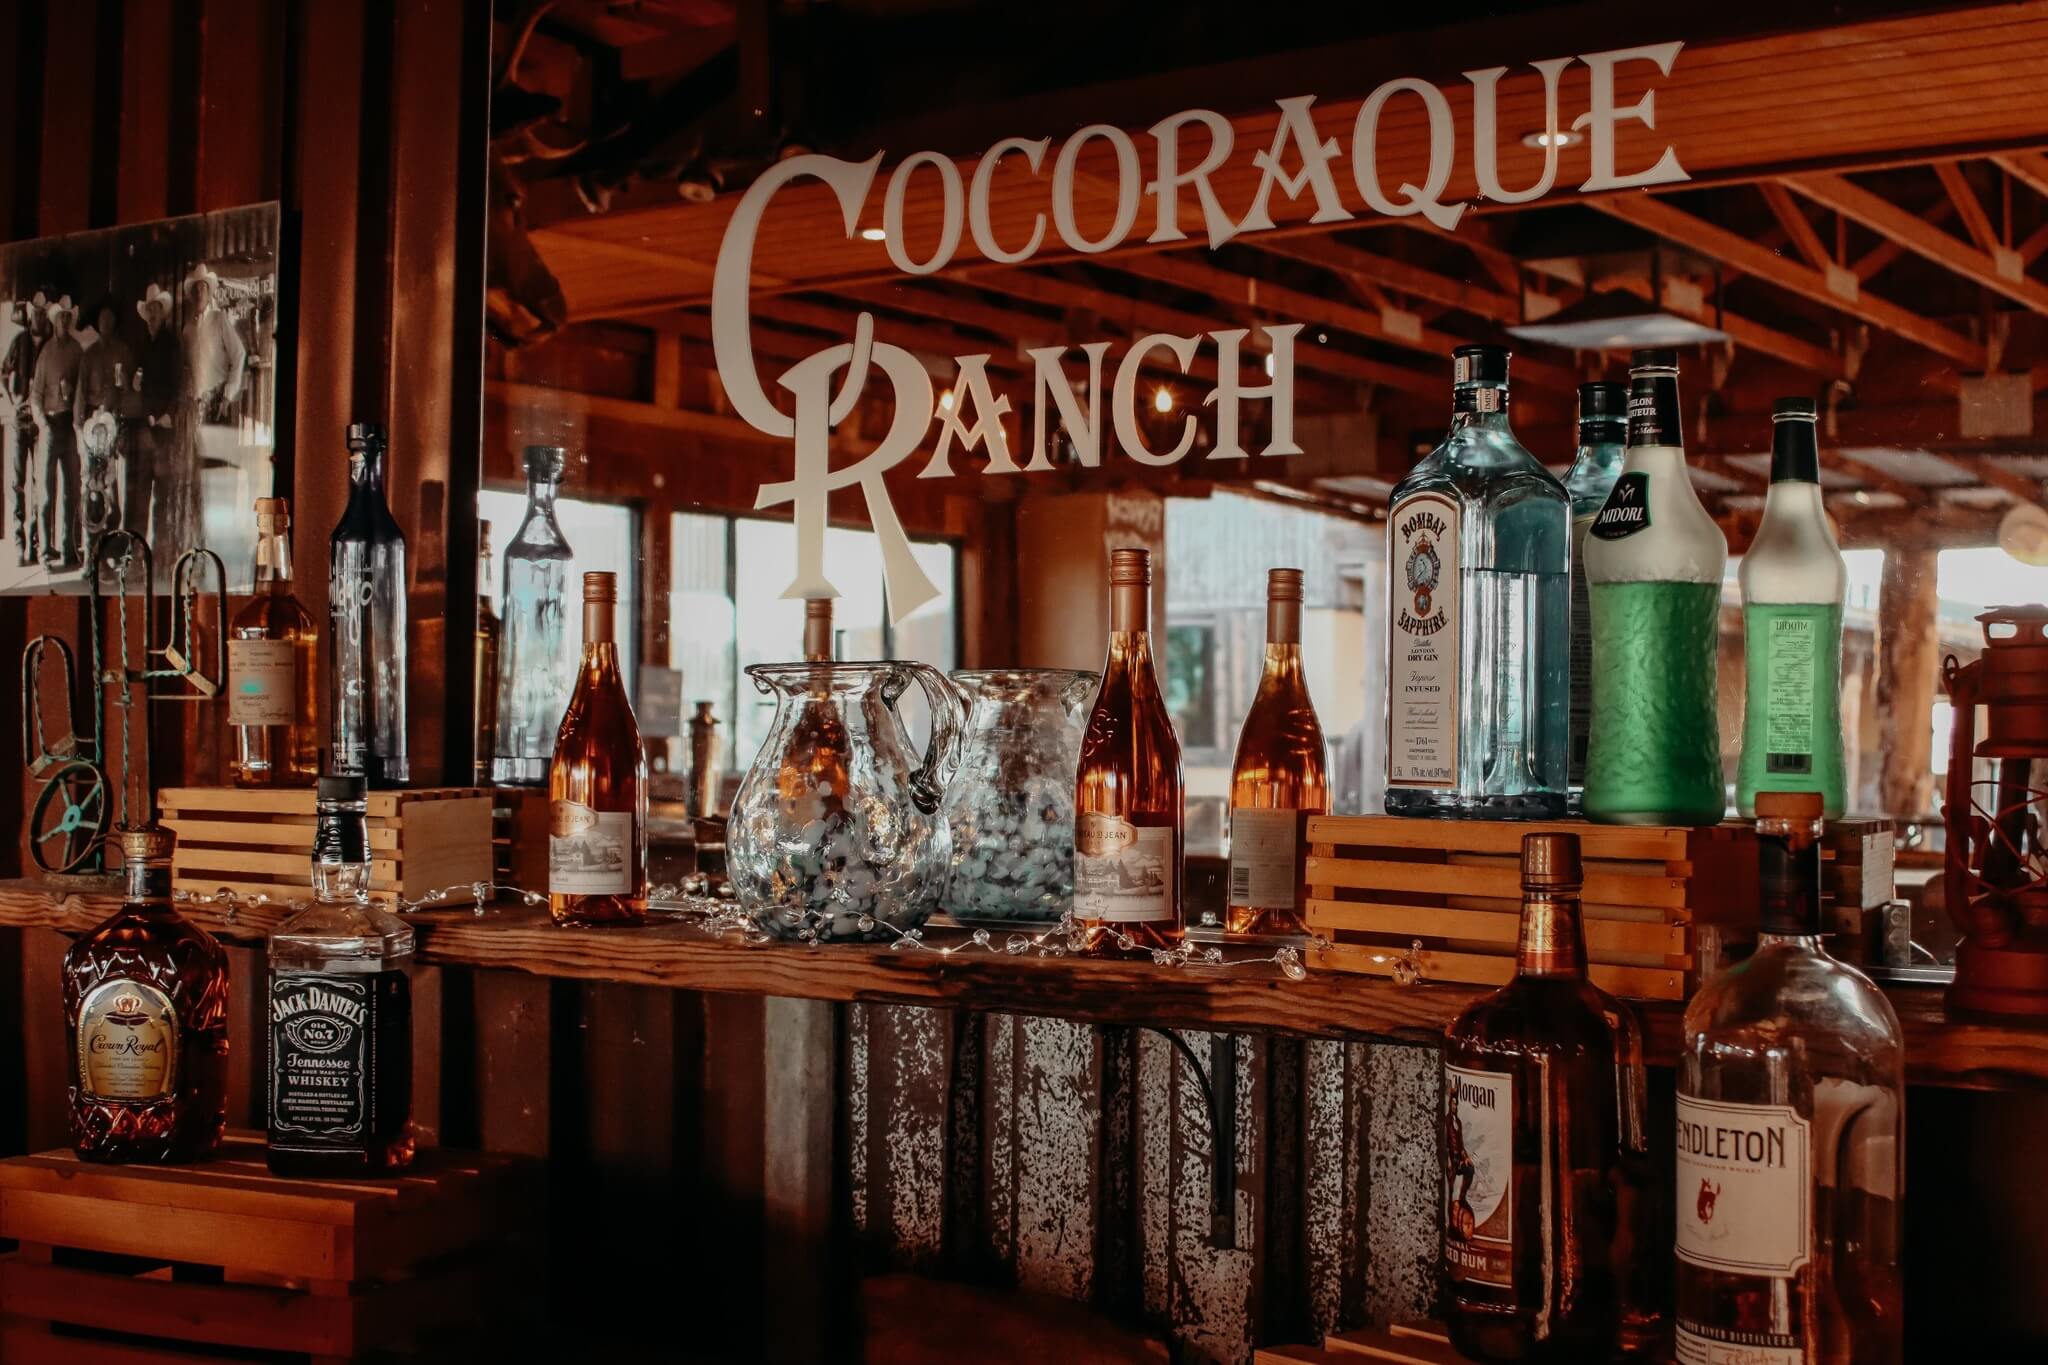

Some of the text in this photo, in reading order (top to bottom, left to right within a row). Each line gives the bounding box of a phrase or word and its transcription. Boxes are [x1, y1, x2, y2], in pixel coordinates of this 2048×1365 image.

[711, 40, 1692, 438] COCORAQUE
[753, 322, 1306, 628] RANCH
[1599, 506, 1644, 525] MIDORI
[1401, 511, 1447, 544] BOMBAY
[1397, 605, 1448, 637] SAPPHIRE
[1407, 654, 1439, 662] DRY GIN
[1405, 685, 1441, 693] INFUSED
[1104, 831, 1127, 840] JEAN
[273, 986, 369, 1027] JACK DANIEL'S
[90, 1034, 163, 1056] Crown Royal
[303, 1029, 335, 1041] No.7
[287, 1053, 352, 1070] Tennessee
[287, 1075, 350, 1088] WHISKEY
[1677, 1119, 1786, 1168] ENDLETON
[1460, 1252, 1487, 1272] RUM
